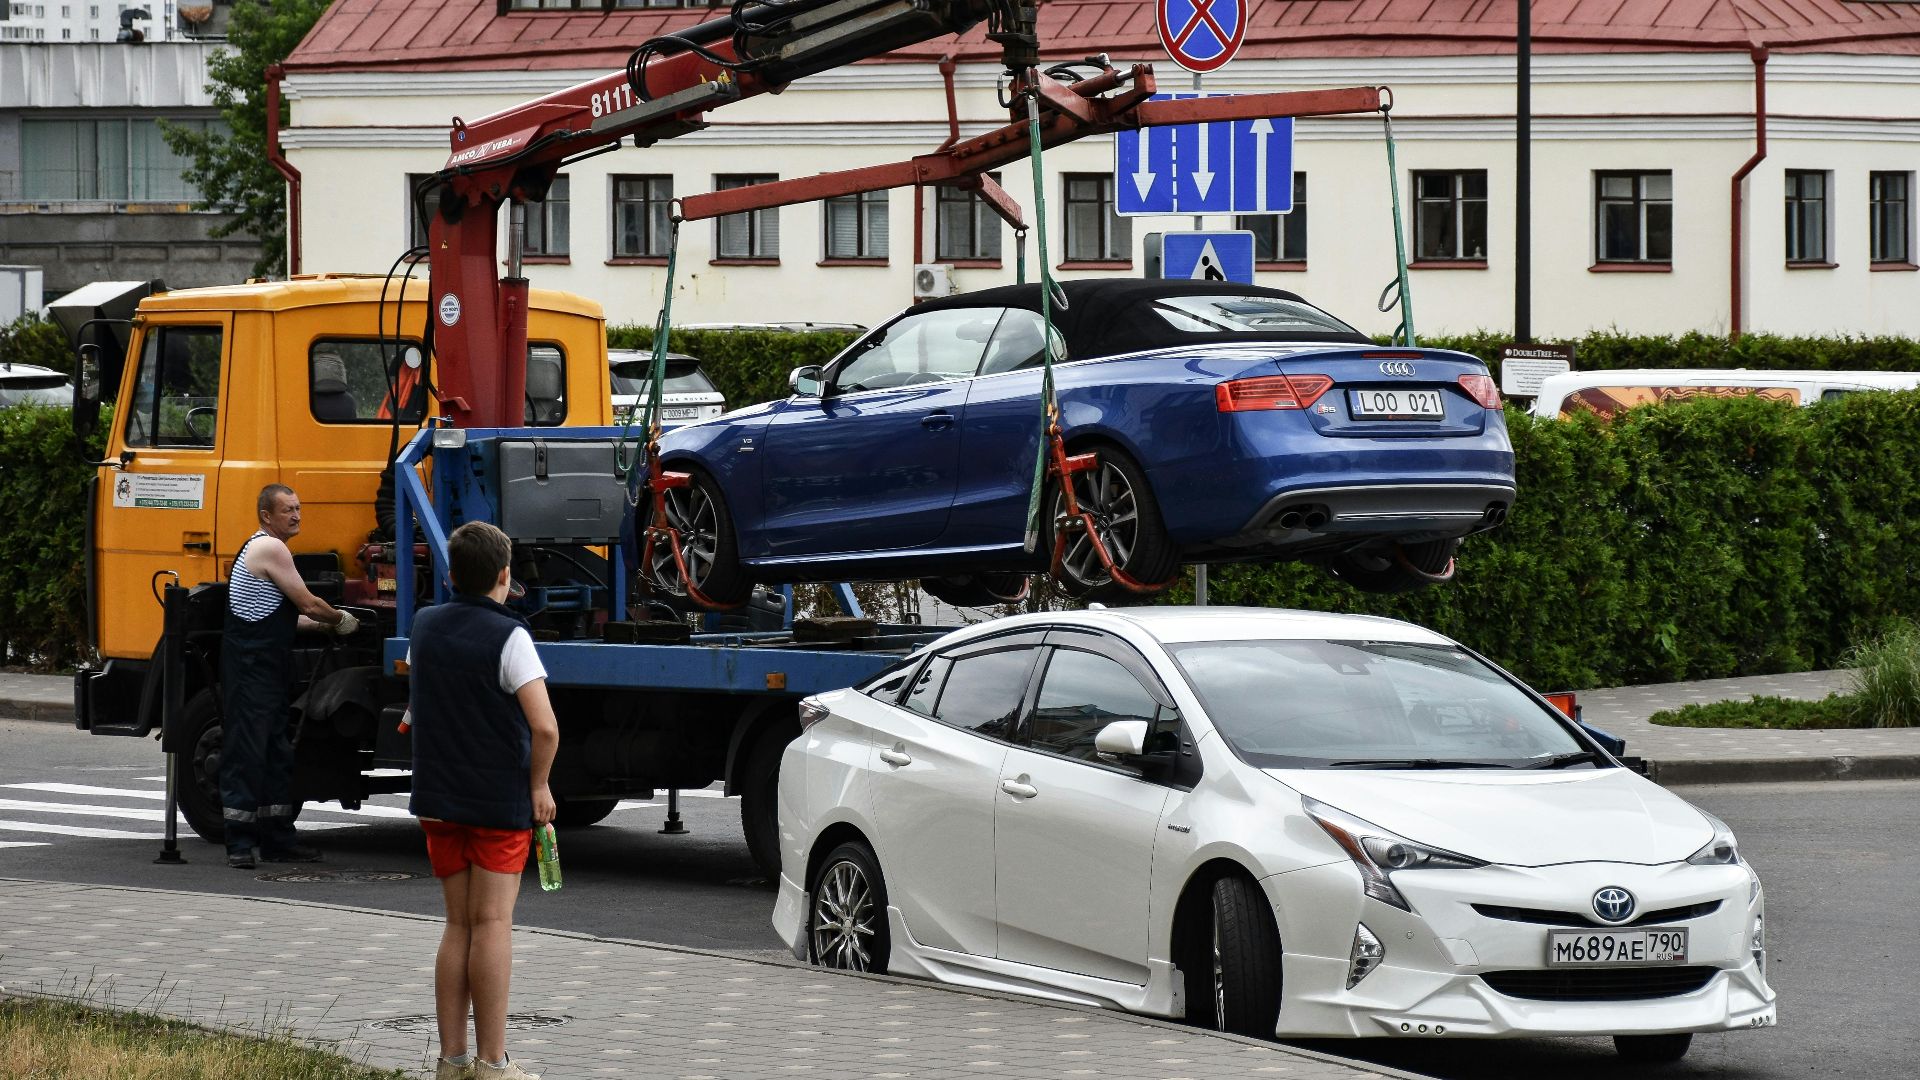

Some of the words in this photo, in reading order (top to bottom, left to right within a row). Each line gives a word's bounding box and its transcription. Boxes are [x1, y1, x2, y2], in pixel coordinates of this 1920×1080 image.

[591, 82, 632, 118] 811T
[451, 150, 476, 164] AMCO
[492, 138, 513, 151] VEBA
[1360, 393, 1398, 413] LOO
[1408, 393, 1438, 413] 021
[1557, 936, 1644, 961] M689AE
[1648, 933, 1682, 952] 790
[1656, 953, 1673, 961] RUS
